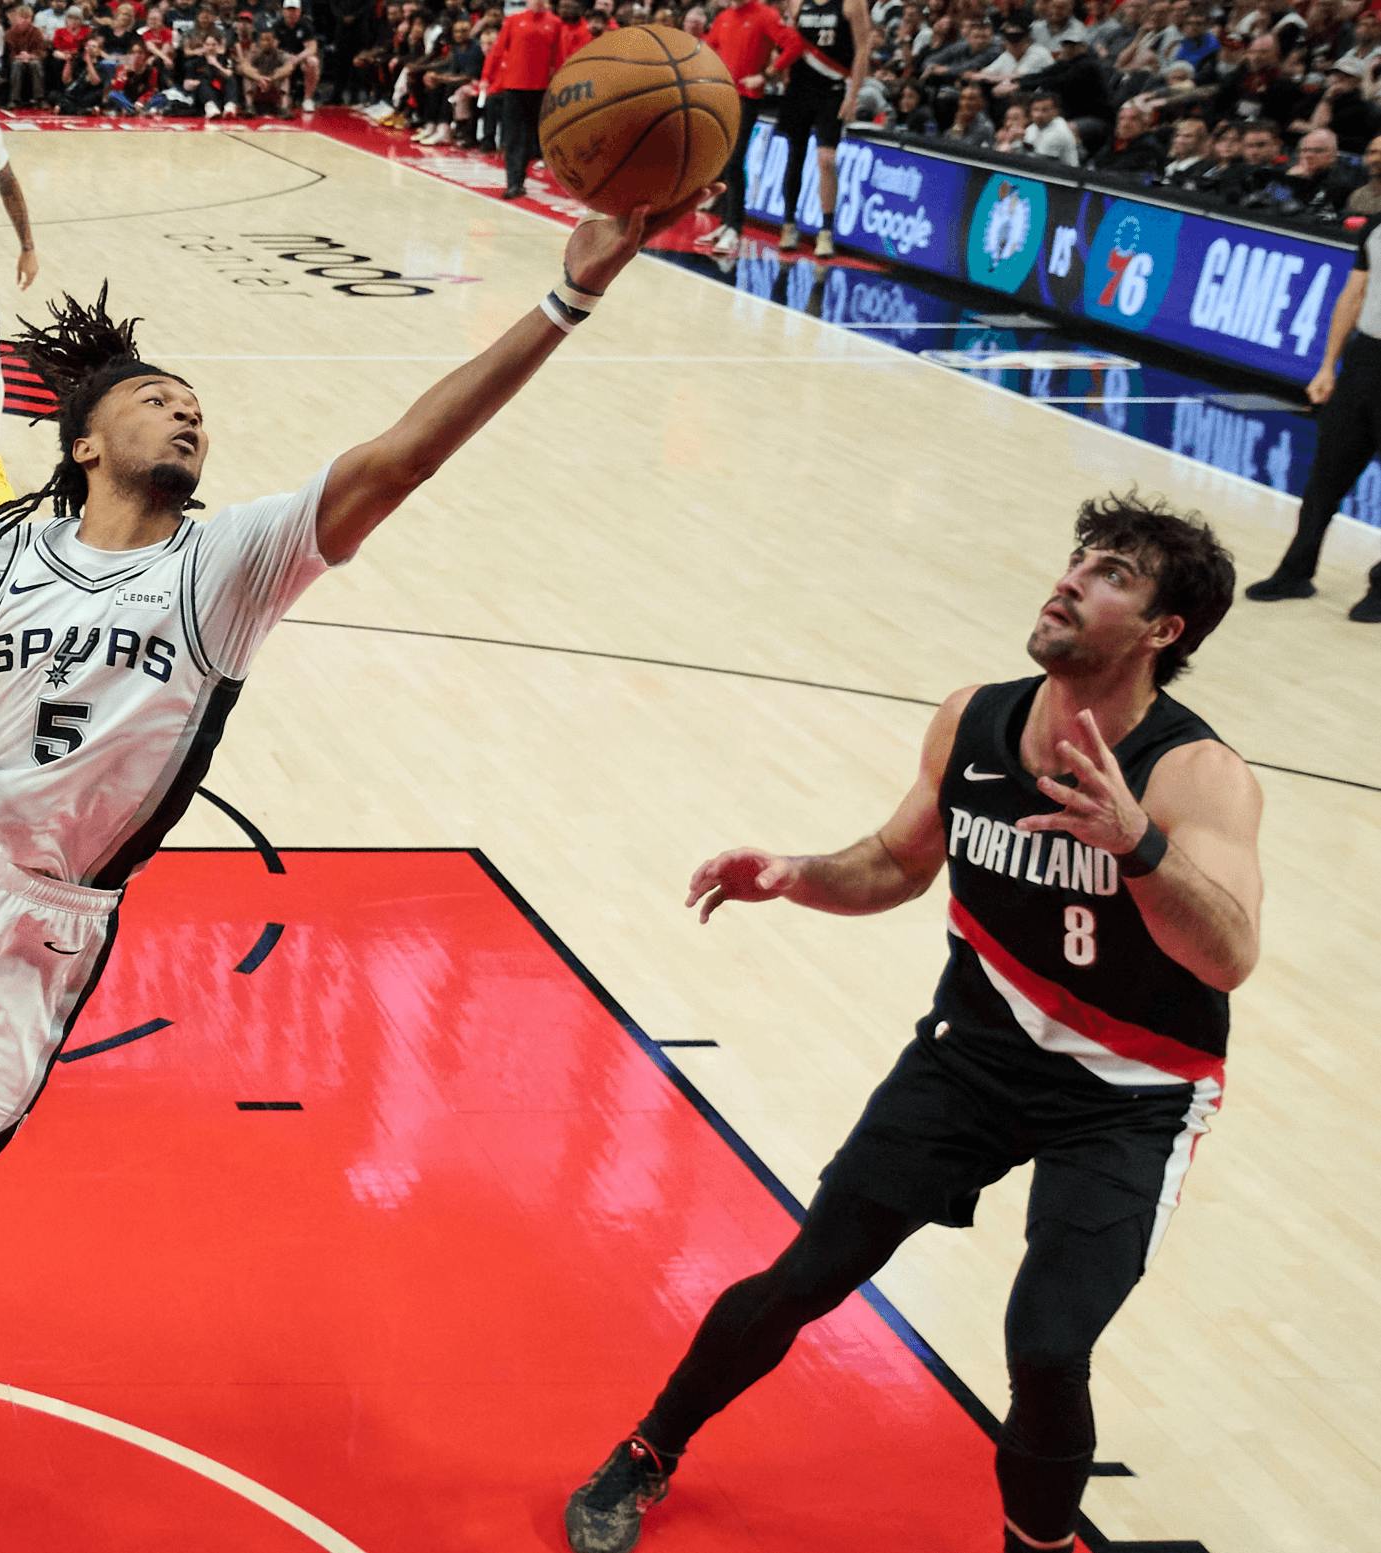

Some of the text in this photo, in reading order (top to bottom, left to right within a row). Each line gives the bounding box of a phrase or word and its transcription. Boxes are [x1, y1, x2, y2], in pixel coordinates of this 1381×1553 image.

[863, 193, 933, 254] Google
[1189, 237, 1332, 357] GAME 4
[122, 593, 164, 604] LEDGER
[31, 697, 93, 767] 5
[949, 807, 1118, 896] PORTLAND
[1063, 905, 1098, 966] 8
